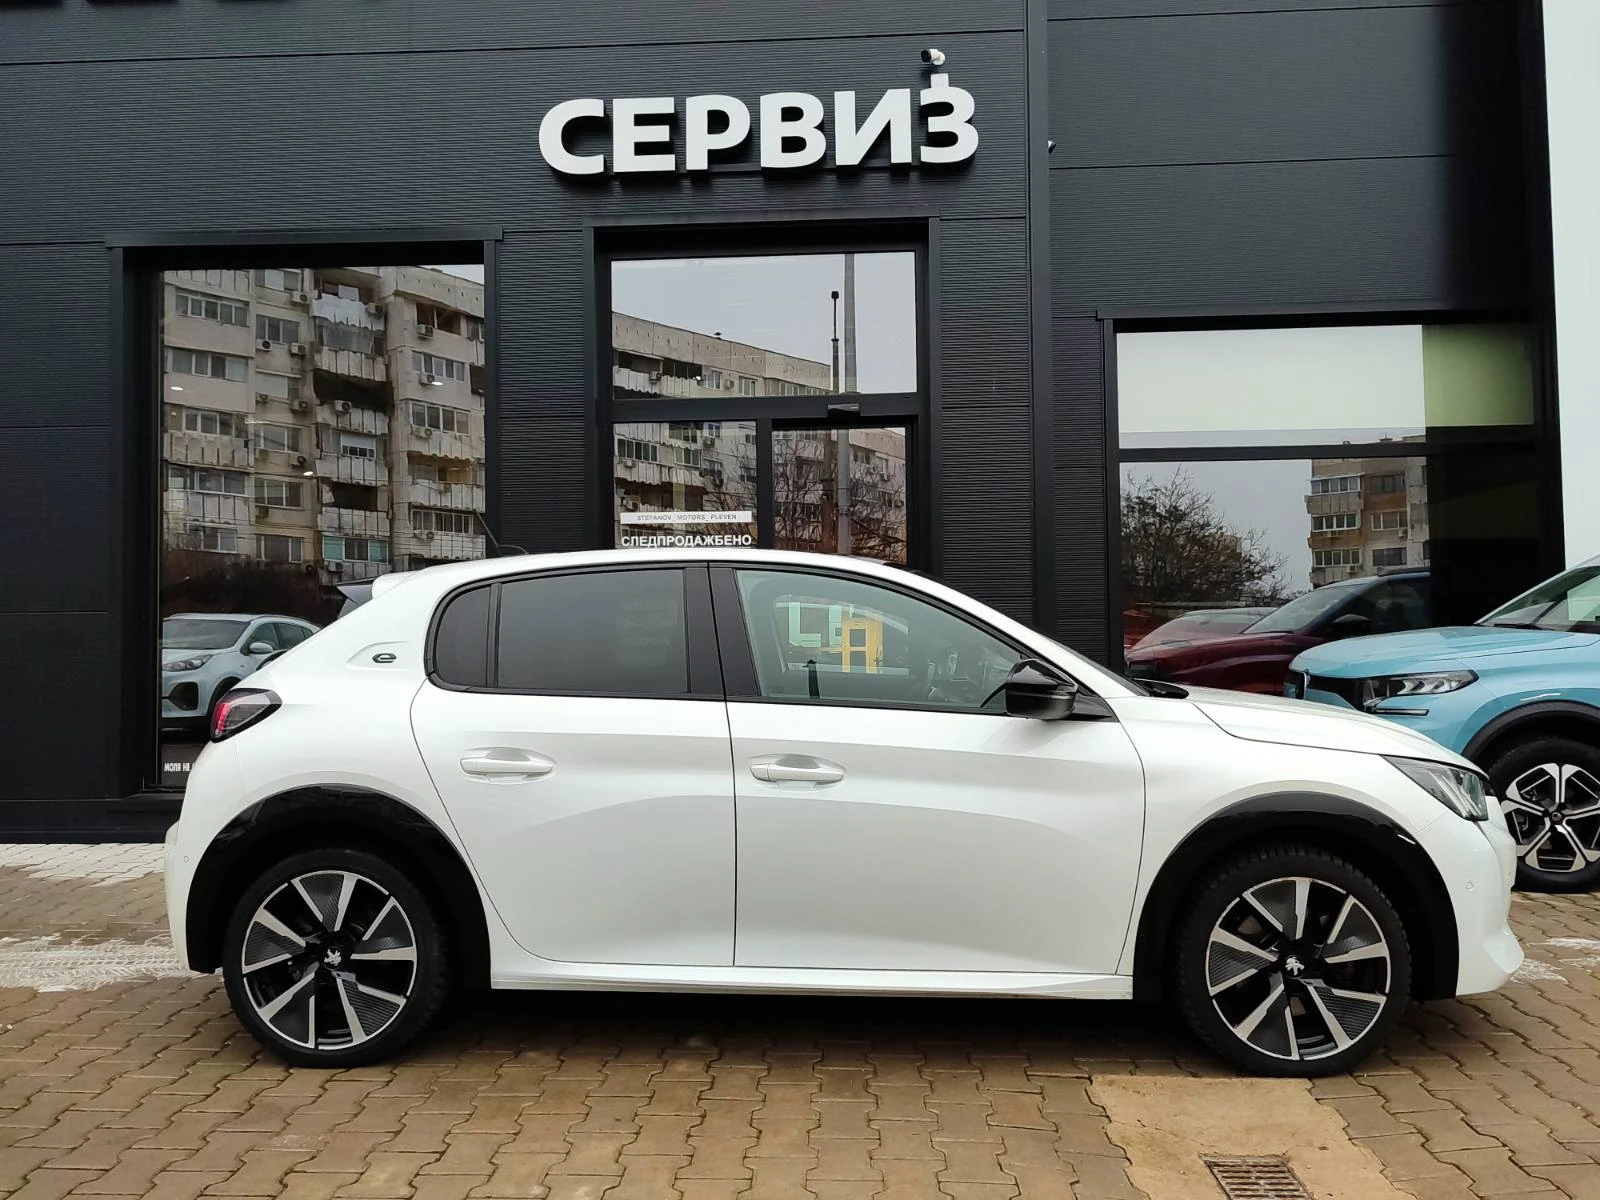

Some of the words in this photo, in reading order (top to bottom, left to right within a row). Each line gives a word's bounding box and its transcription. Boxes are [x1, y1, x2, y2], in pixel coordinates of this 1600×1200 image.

[538, 86, 979, 175] СЕРВИЗ
[710, 513, 737, 521] PLEVEN
[621, 534, 752, 548] СЛЕДПРОДАЖБЕНО
